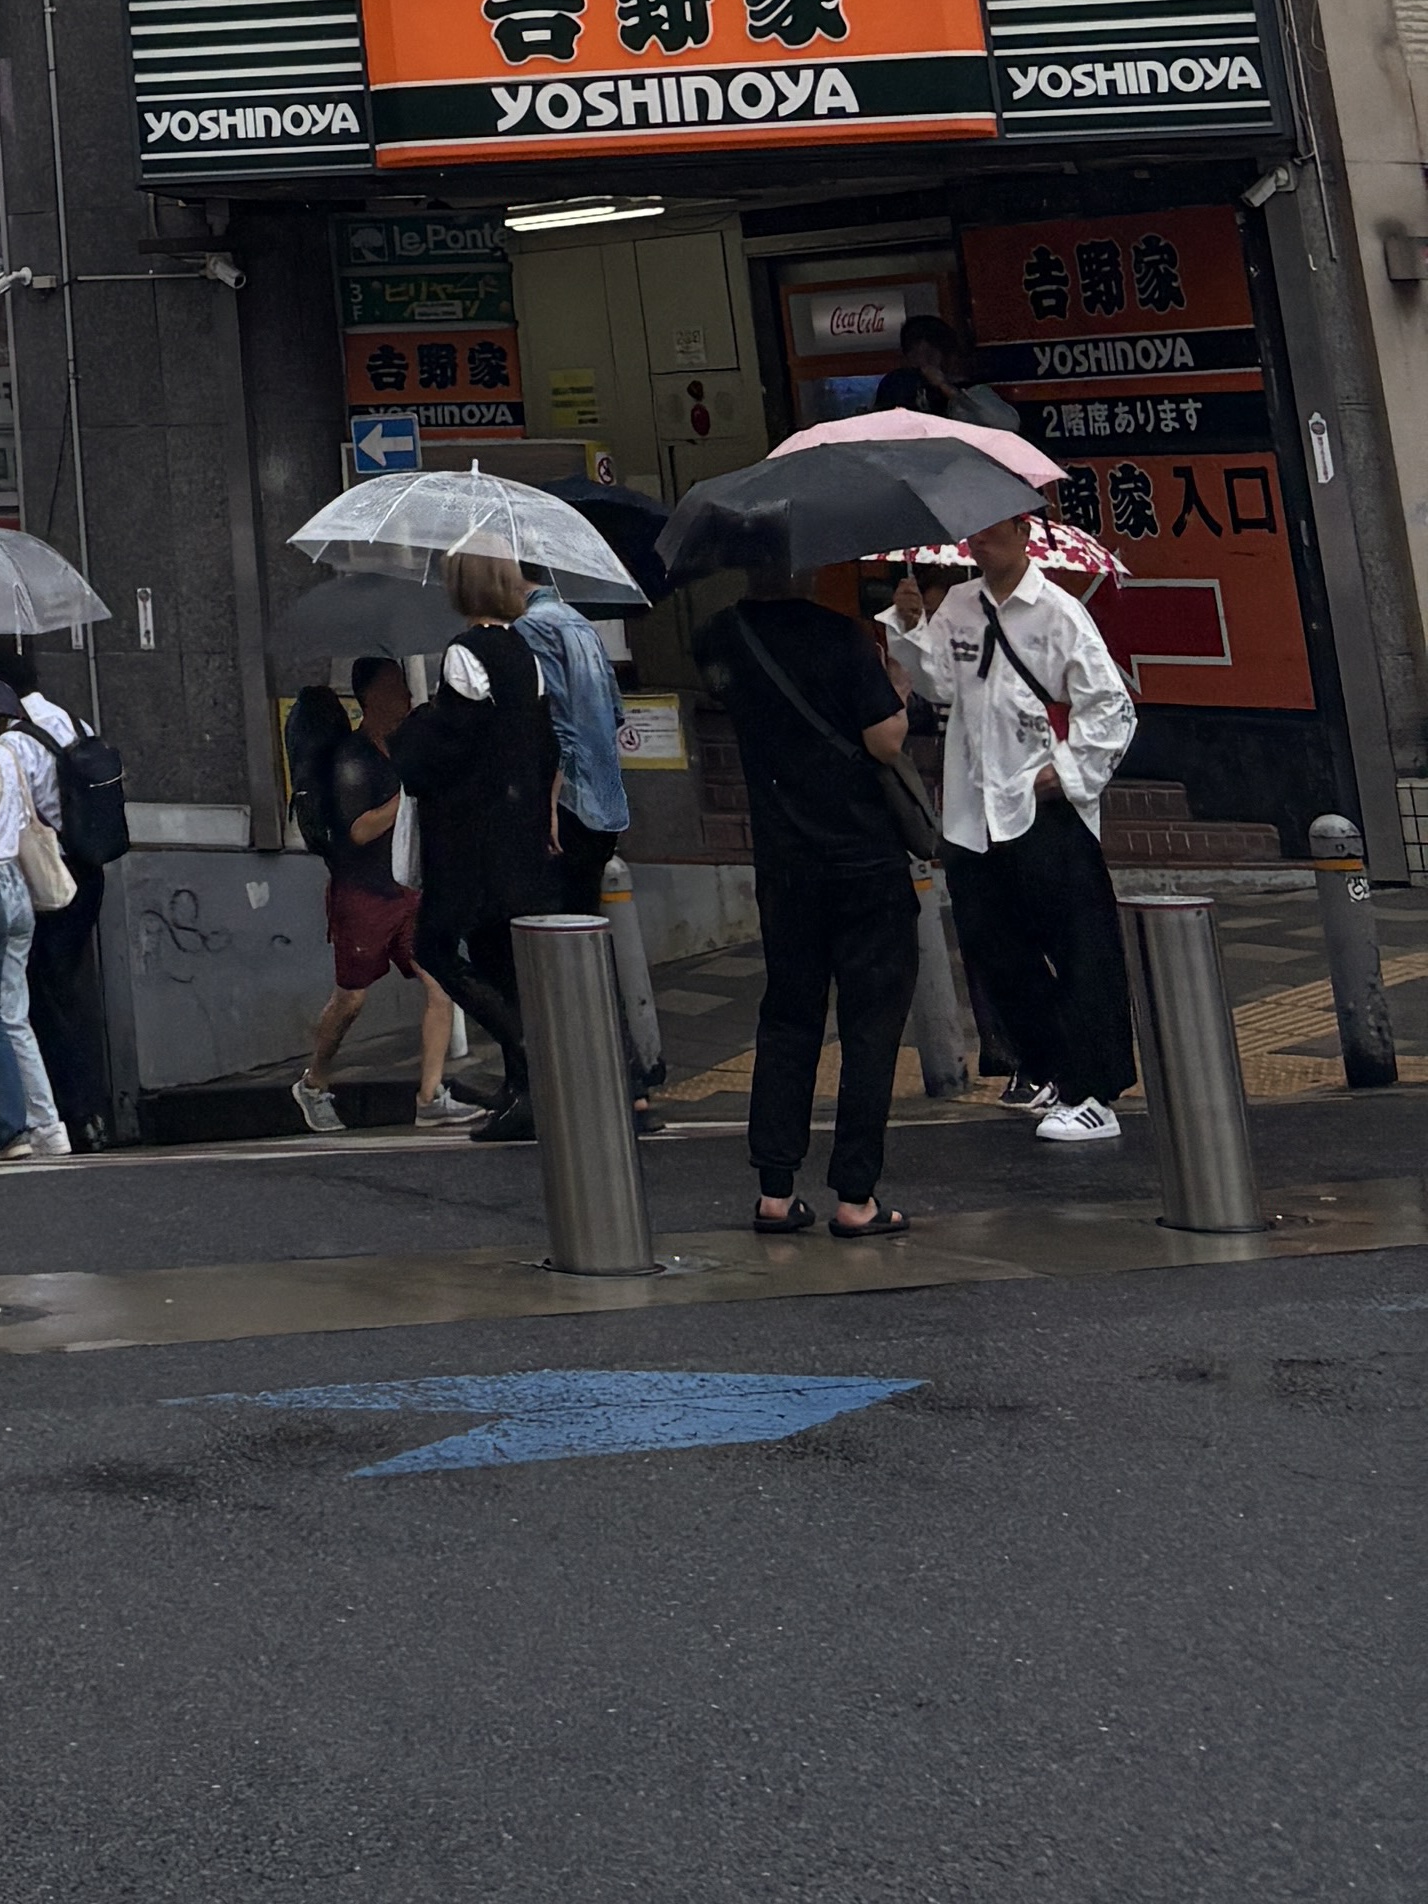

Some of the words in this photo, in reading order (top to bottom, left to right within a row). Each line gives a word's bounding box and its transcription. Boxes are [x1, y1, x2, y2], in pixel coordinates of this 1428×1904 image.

[491, 67, 861, 135] YOSHINOYA
[1006, 54, 1262, 101] YOSHINOYA
[144, 100, 361, 146] YOSHINOYA
[1023, 233, 1187, 321] 吉野家
[367, 341, 510, 391] 吉野家
[1034, 337, 1194, 376] YOSHINOYA
[1043, 398, 1202, 439] 2階席あります
[1058, 461, 1277, 540] 野家入口
